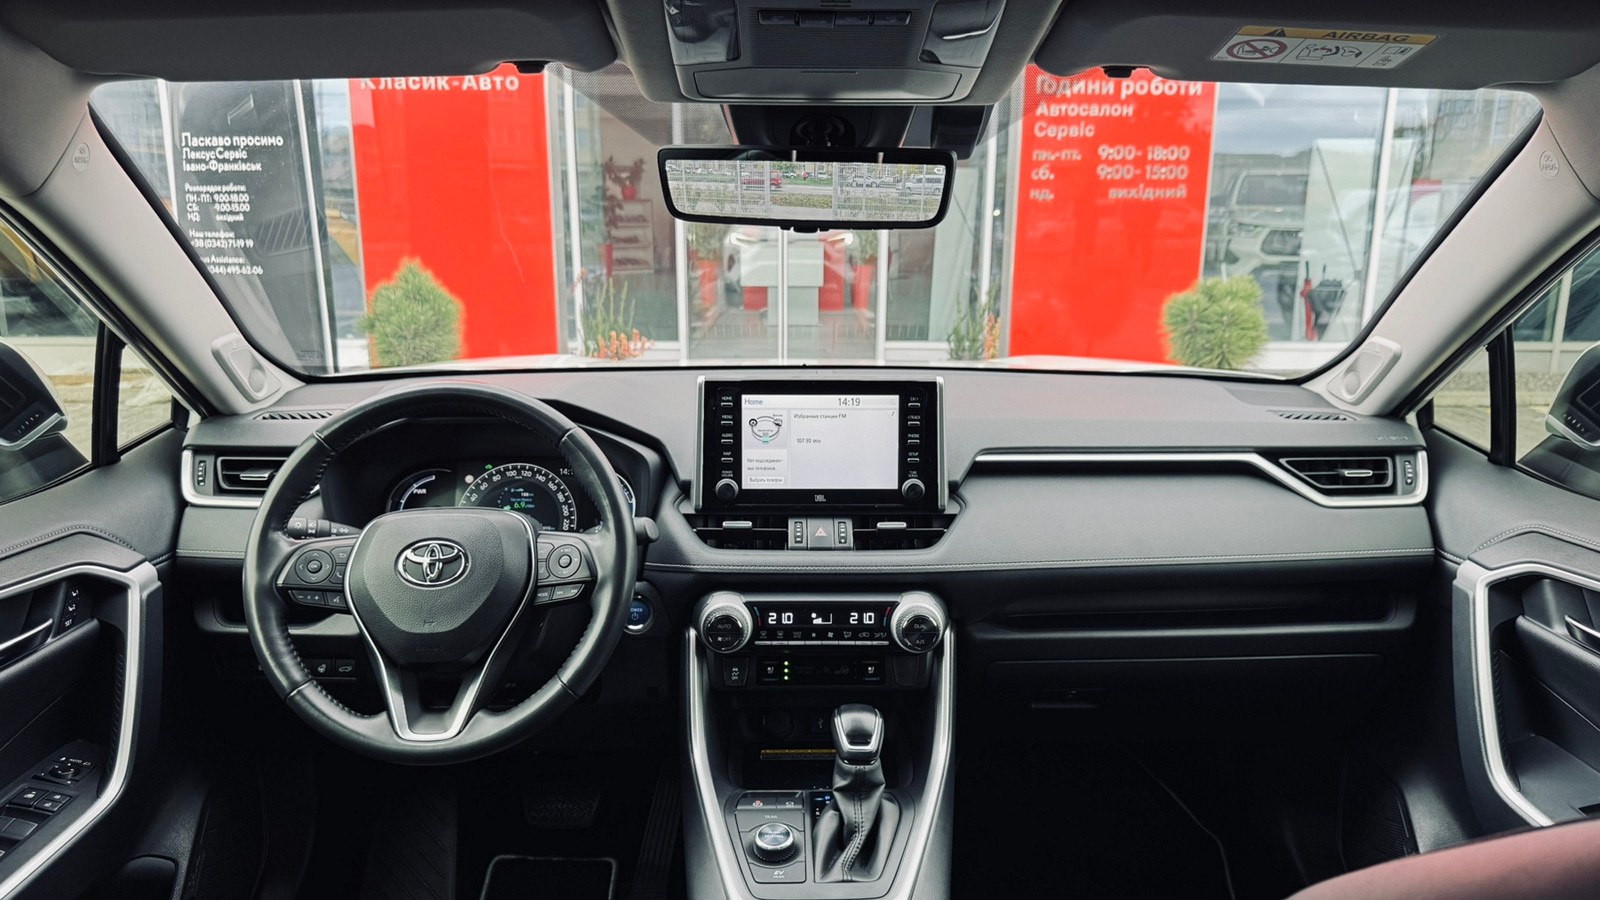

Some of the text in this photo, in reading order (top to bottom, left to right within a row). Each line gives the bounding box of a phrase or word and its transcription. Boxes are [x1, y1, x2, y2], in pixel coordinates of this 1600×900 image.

[1321, 31, 1410, 42] AIRBAG
[361, 74, 520, 91] Класик-Авто
[1036, 75, 1202, 99] Години роботи
[1035, 101, 1134, 117] Автосалон
[1034, 122, 1096, 140] Сервіс
[181, 132, 284, 149] Ласкаво просимо
[1109, 183, 1187, 200] вихідний
[744, 397, 861, 407] Home 14:19
[491, 474, 502, 482] 80
[521, 470, 533, 478] 120
[535, 473, 546, 483] 140
[479, 481, 489, 491] 60
[547, 481, 558, 491] 160
[556, 491, 566, 503] 180
[562, 504, 570, 516] 200
[562, 518, 570, 531] 220
